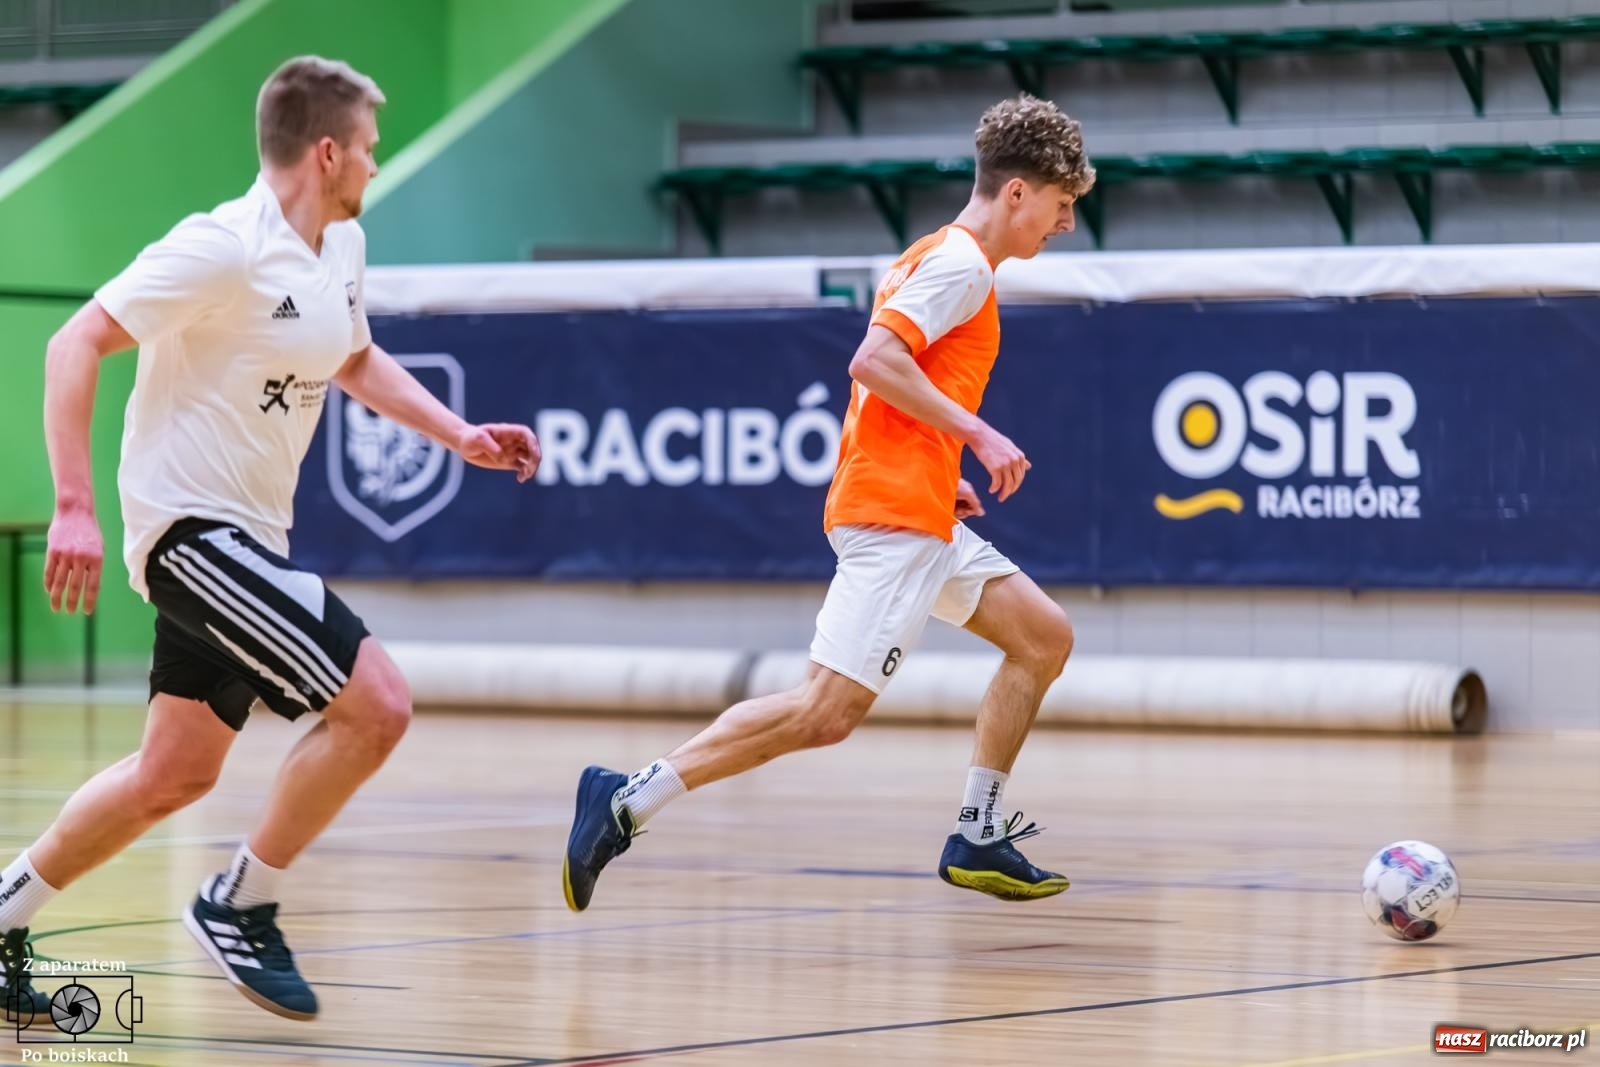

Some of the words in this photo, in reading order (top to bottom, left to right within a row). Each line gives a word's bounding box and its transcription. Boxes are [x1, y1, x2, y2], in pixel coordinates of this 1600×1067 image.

[535, 381, 843, 487] RACIBÓ
[1257, 477, 1421, 519] RACIBÓRZ
[881, 647, 902, 677] 6
[1415, 872, 1453, 911] SELECT
